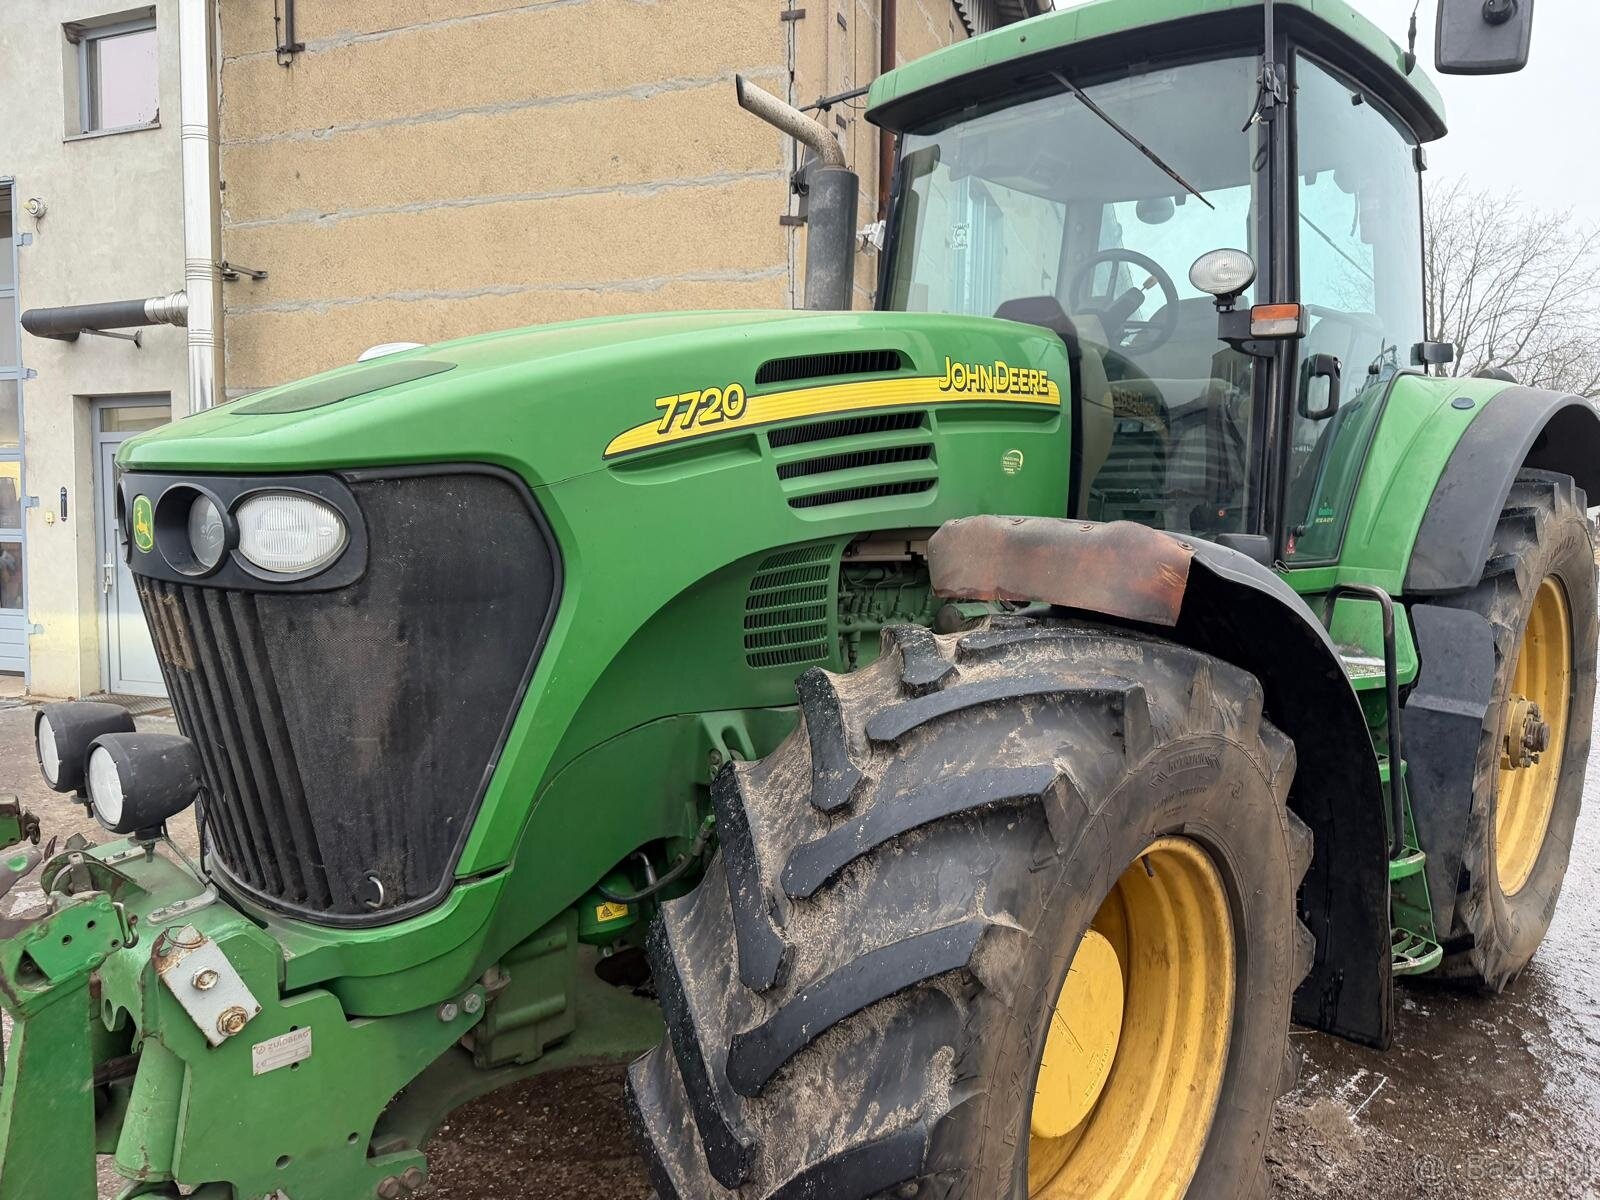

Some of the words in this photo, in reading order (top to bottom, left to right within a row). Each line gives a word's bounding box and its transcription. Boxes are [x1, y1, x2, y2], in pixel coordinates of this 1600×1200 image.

[939, 355, 993, 392] JOHN
[994, 360, 1049, 395] DEERE
[655, 382, 746, 434] 7720
